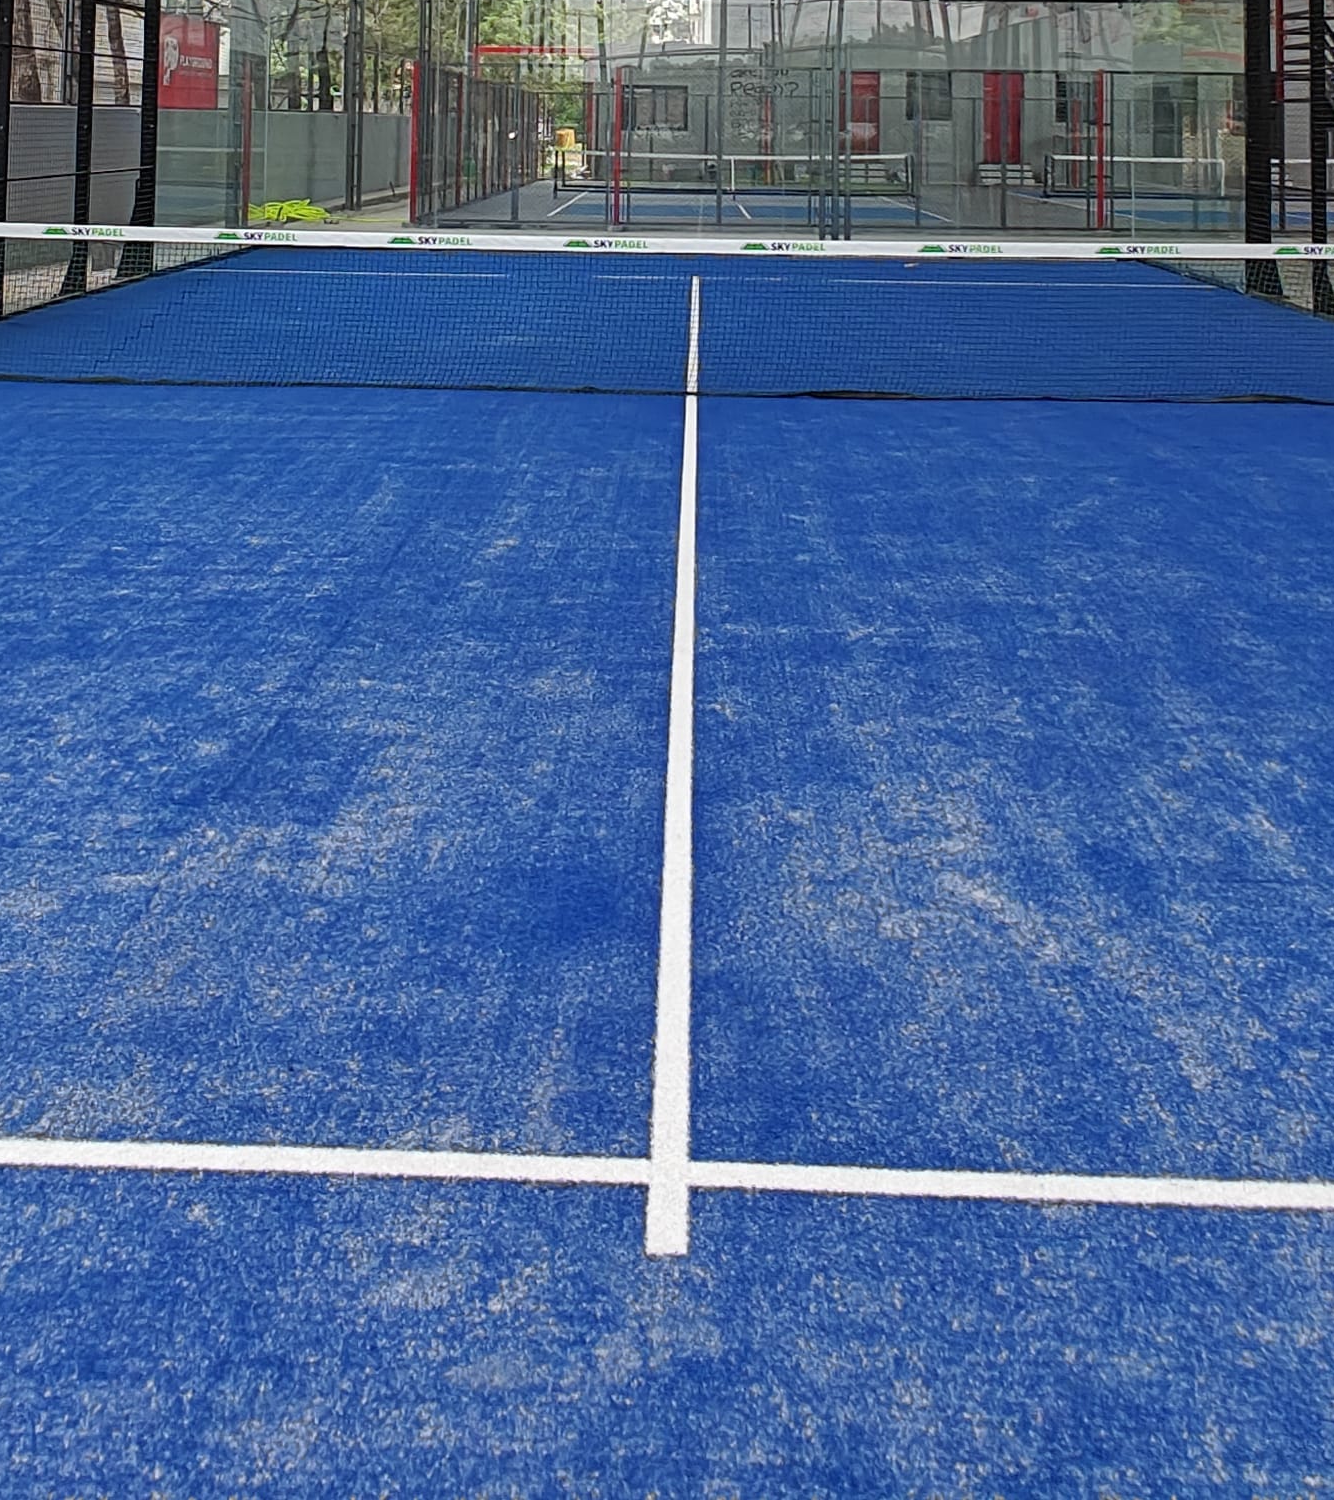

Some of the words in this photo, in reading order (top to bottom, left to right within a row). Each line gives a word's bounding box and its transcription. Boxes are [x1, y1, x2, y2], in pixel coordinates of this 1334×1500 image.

[71, 227, 125, 237] SKYPADEL
[244, 232, 298, 242] SKYPADEL
[418, 236, 473, 246] SKYPADEL
[593, 240, 648, 249] SKYPADEL
[770, 242, 826, 252] SKYPADEL
[948, 244, 1003, 254] SKYPADEL
[1126, 245, 1181, 255] SKYPADEL
